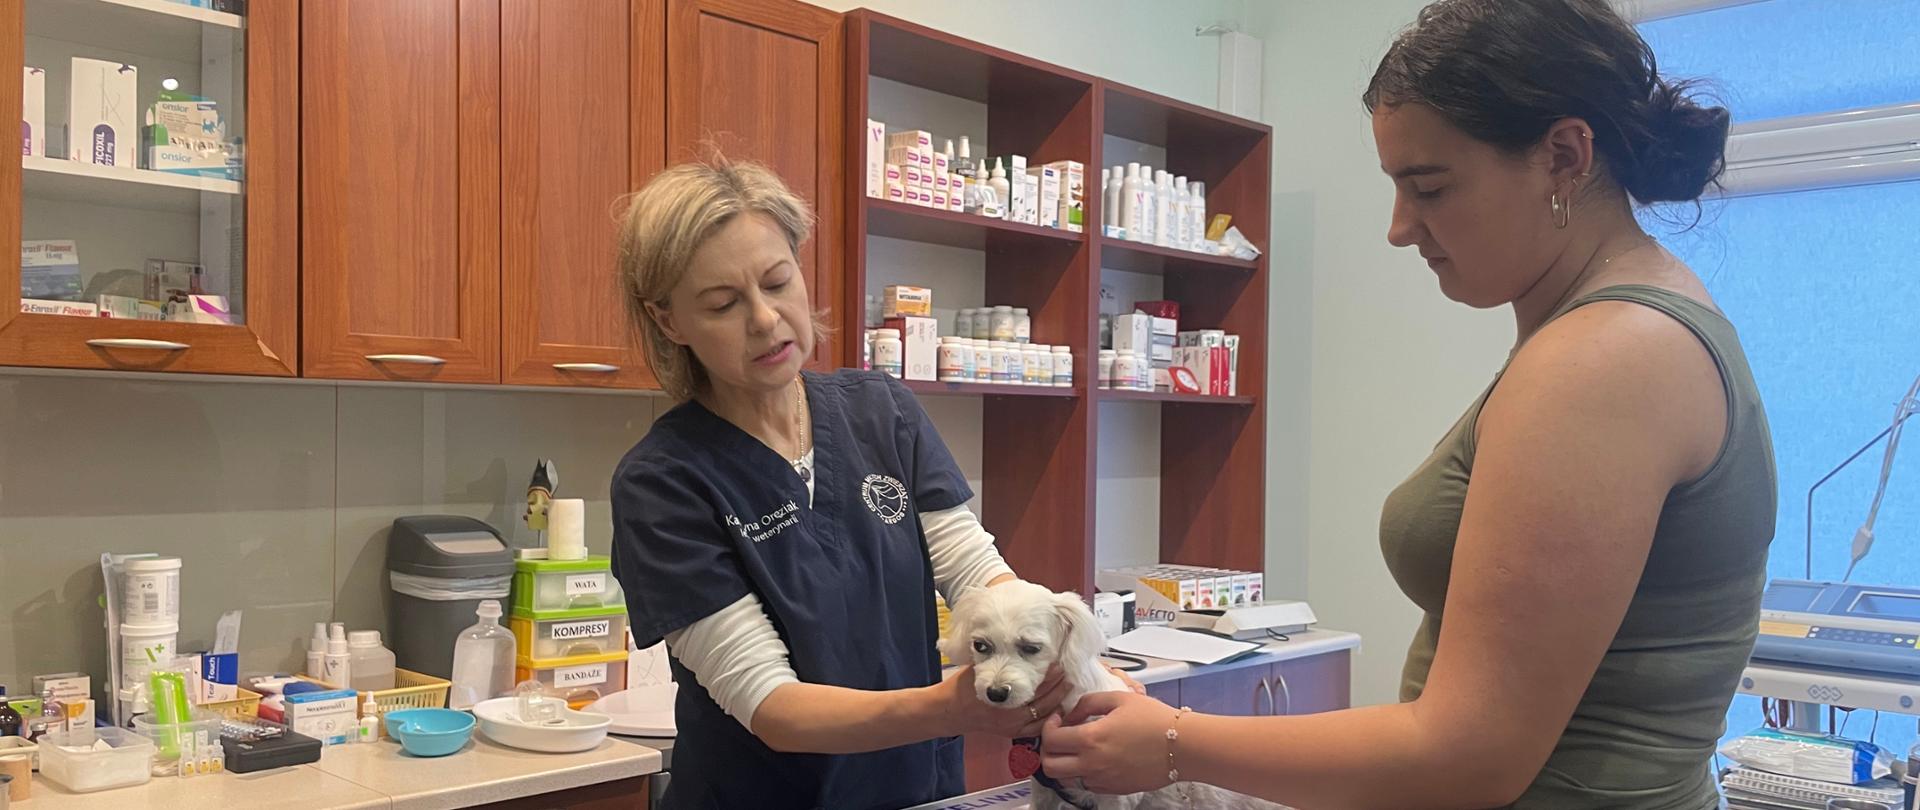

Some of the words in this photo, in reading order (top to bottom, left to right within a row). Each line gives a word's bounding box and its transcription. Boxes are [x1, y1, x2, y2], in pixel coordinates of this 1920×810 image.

[574, 580, 597, 589] WATA
[553, 622, 608, 638] KOMPRESY
[208, 656, 216, 680] Touch
[564, 669, 601, 681] BANDAŻE
